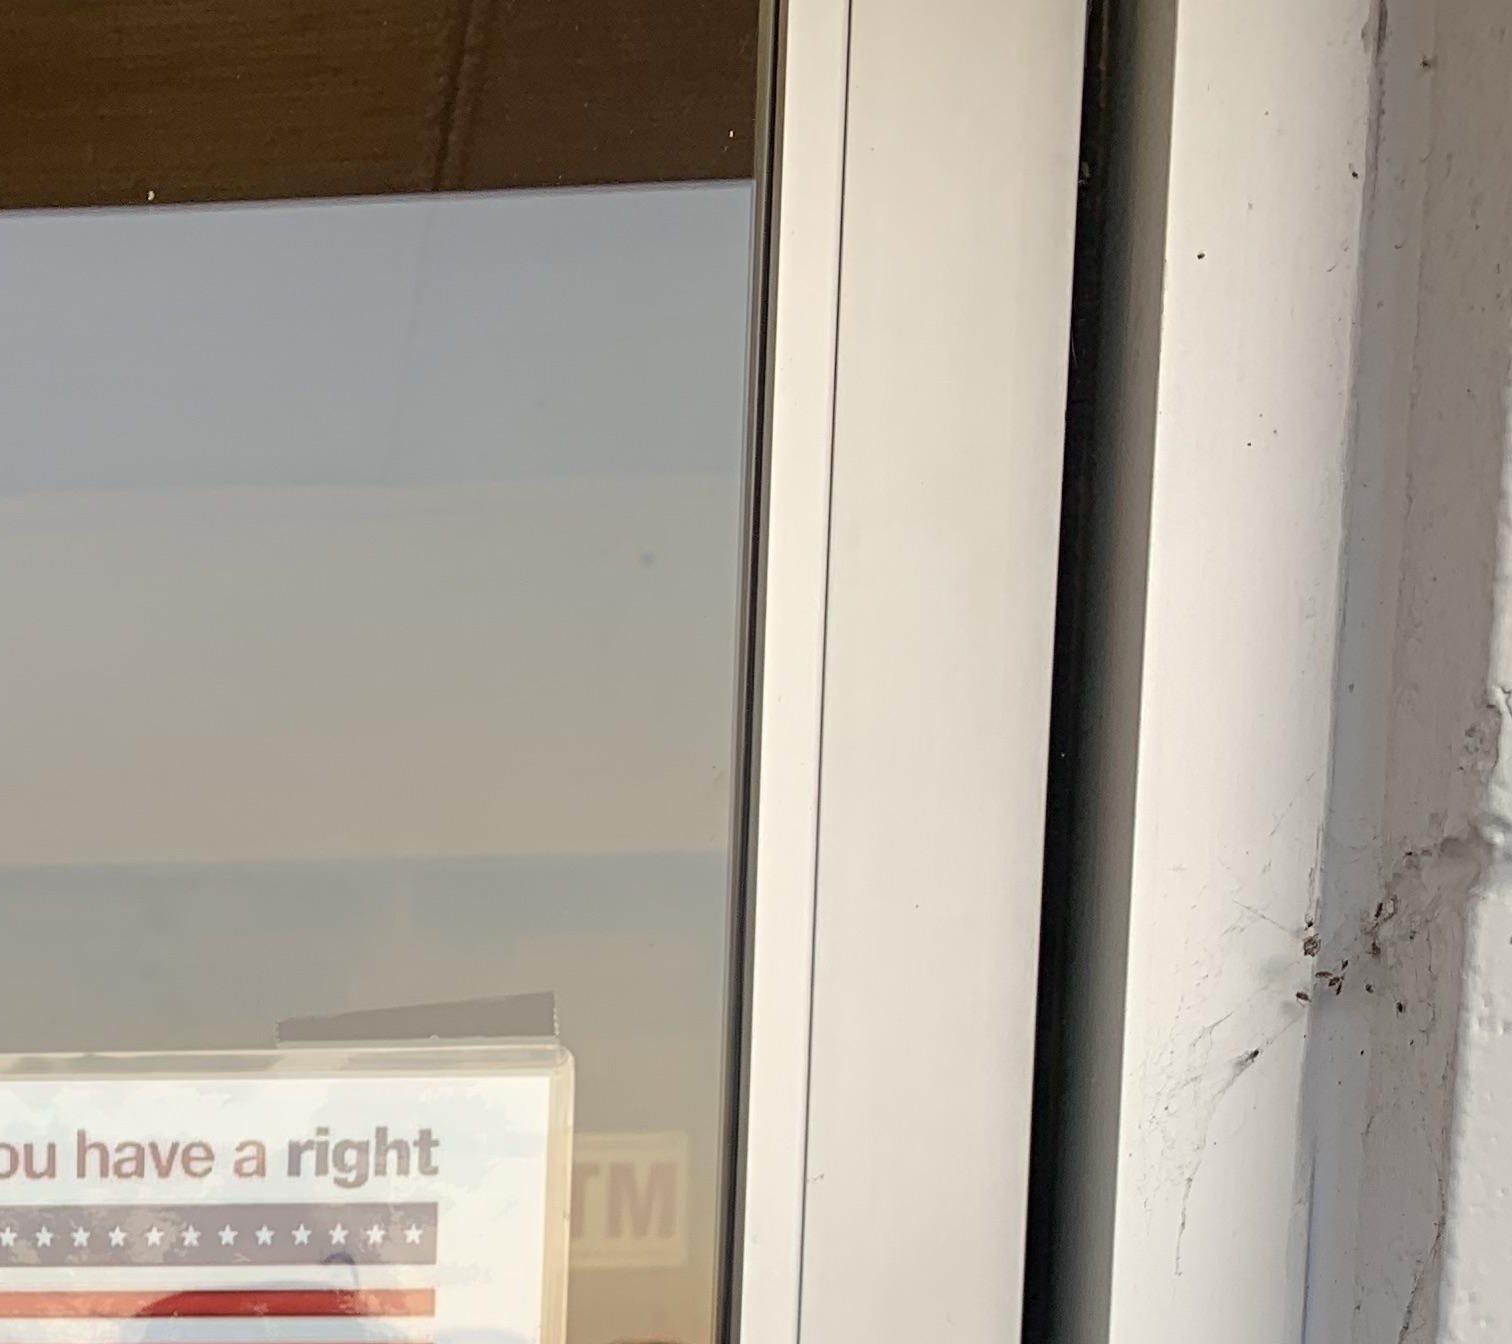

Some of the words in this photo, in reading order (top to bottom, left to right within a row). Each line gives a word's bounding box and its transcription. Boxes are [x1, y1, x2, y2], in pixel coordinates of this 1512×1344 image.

[77, 1129, 215, 1179] have
[233, 1137, 269, 1178] a
[288, 1128, 438, 1190] right
